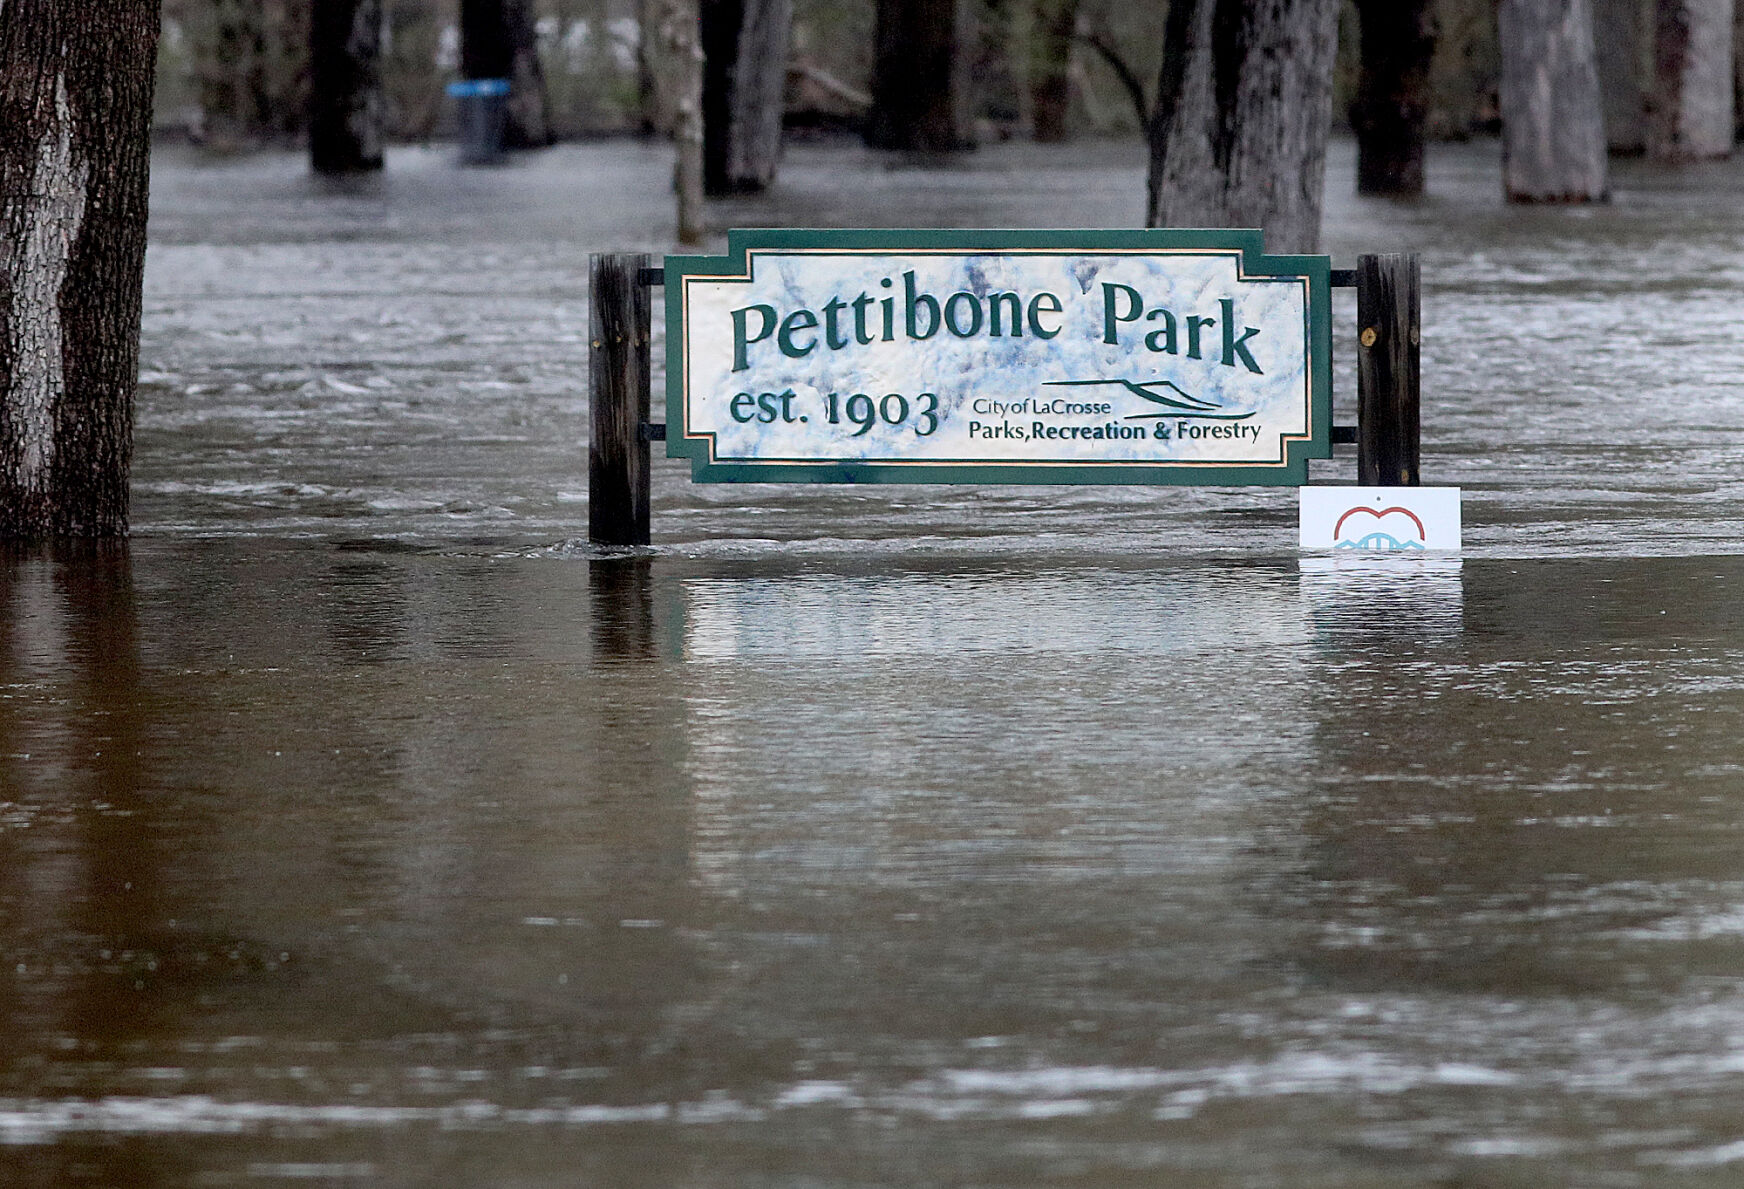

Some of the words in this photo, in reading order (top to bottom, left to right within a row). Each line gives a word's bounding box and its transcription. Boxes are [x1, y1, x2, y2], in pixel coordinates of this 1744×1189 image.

[730, 269, 1063, 373] Pettibone
[1101, 282, 1264, 375] Park
[729, 388, 809, 424] est.
[827, 392, 939, 437] 1903
[1153, 420, 1171, 440] &
[1177, 420, 1262, 444] Forestry
